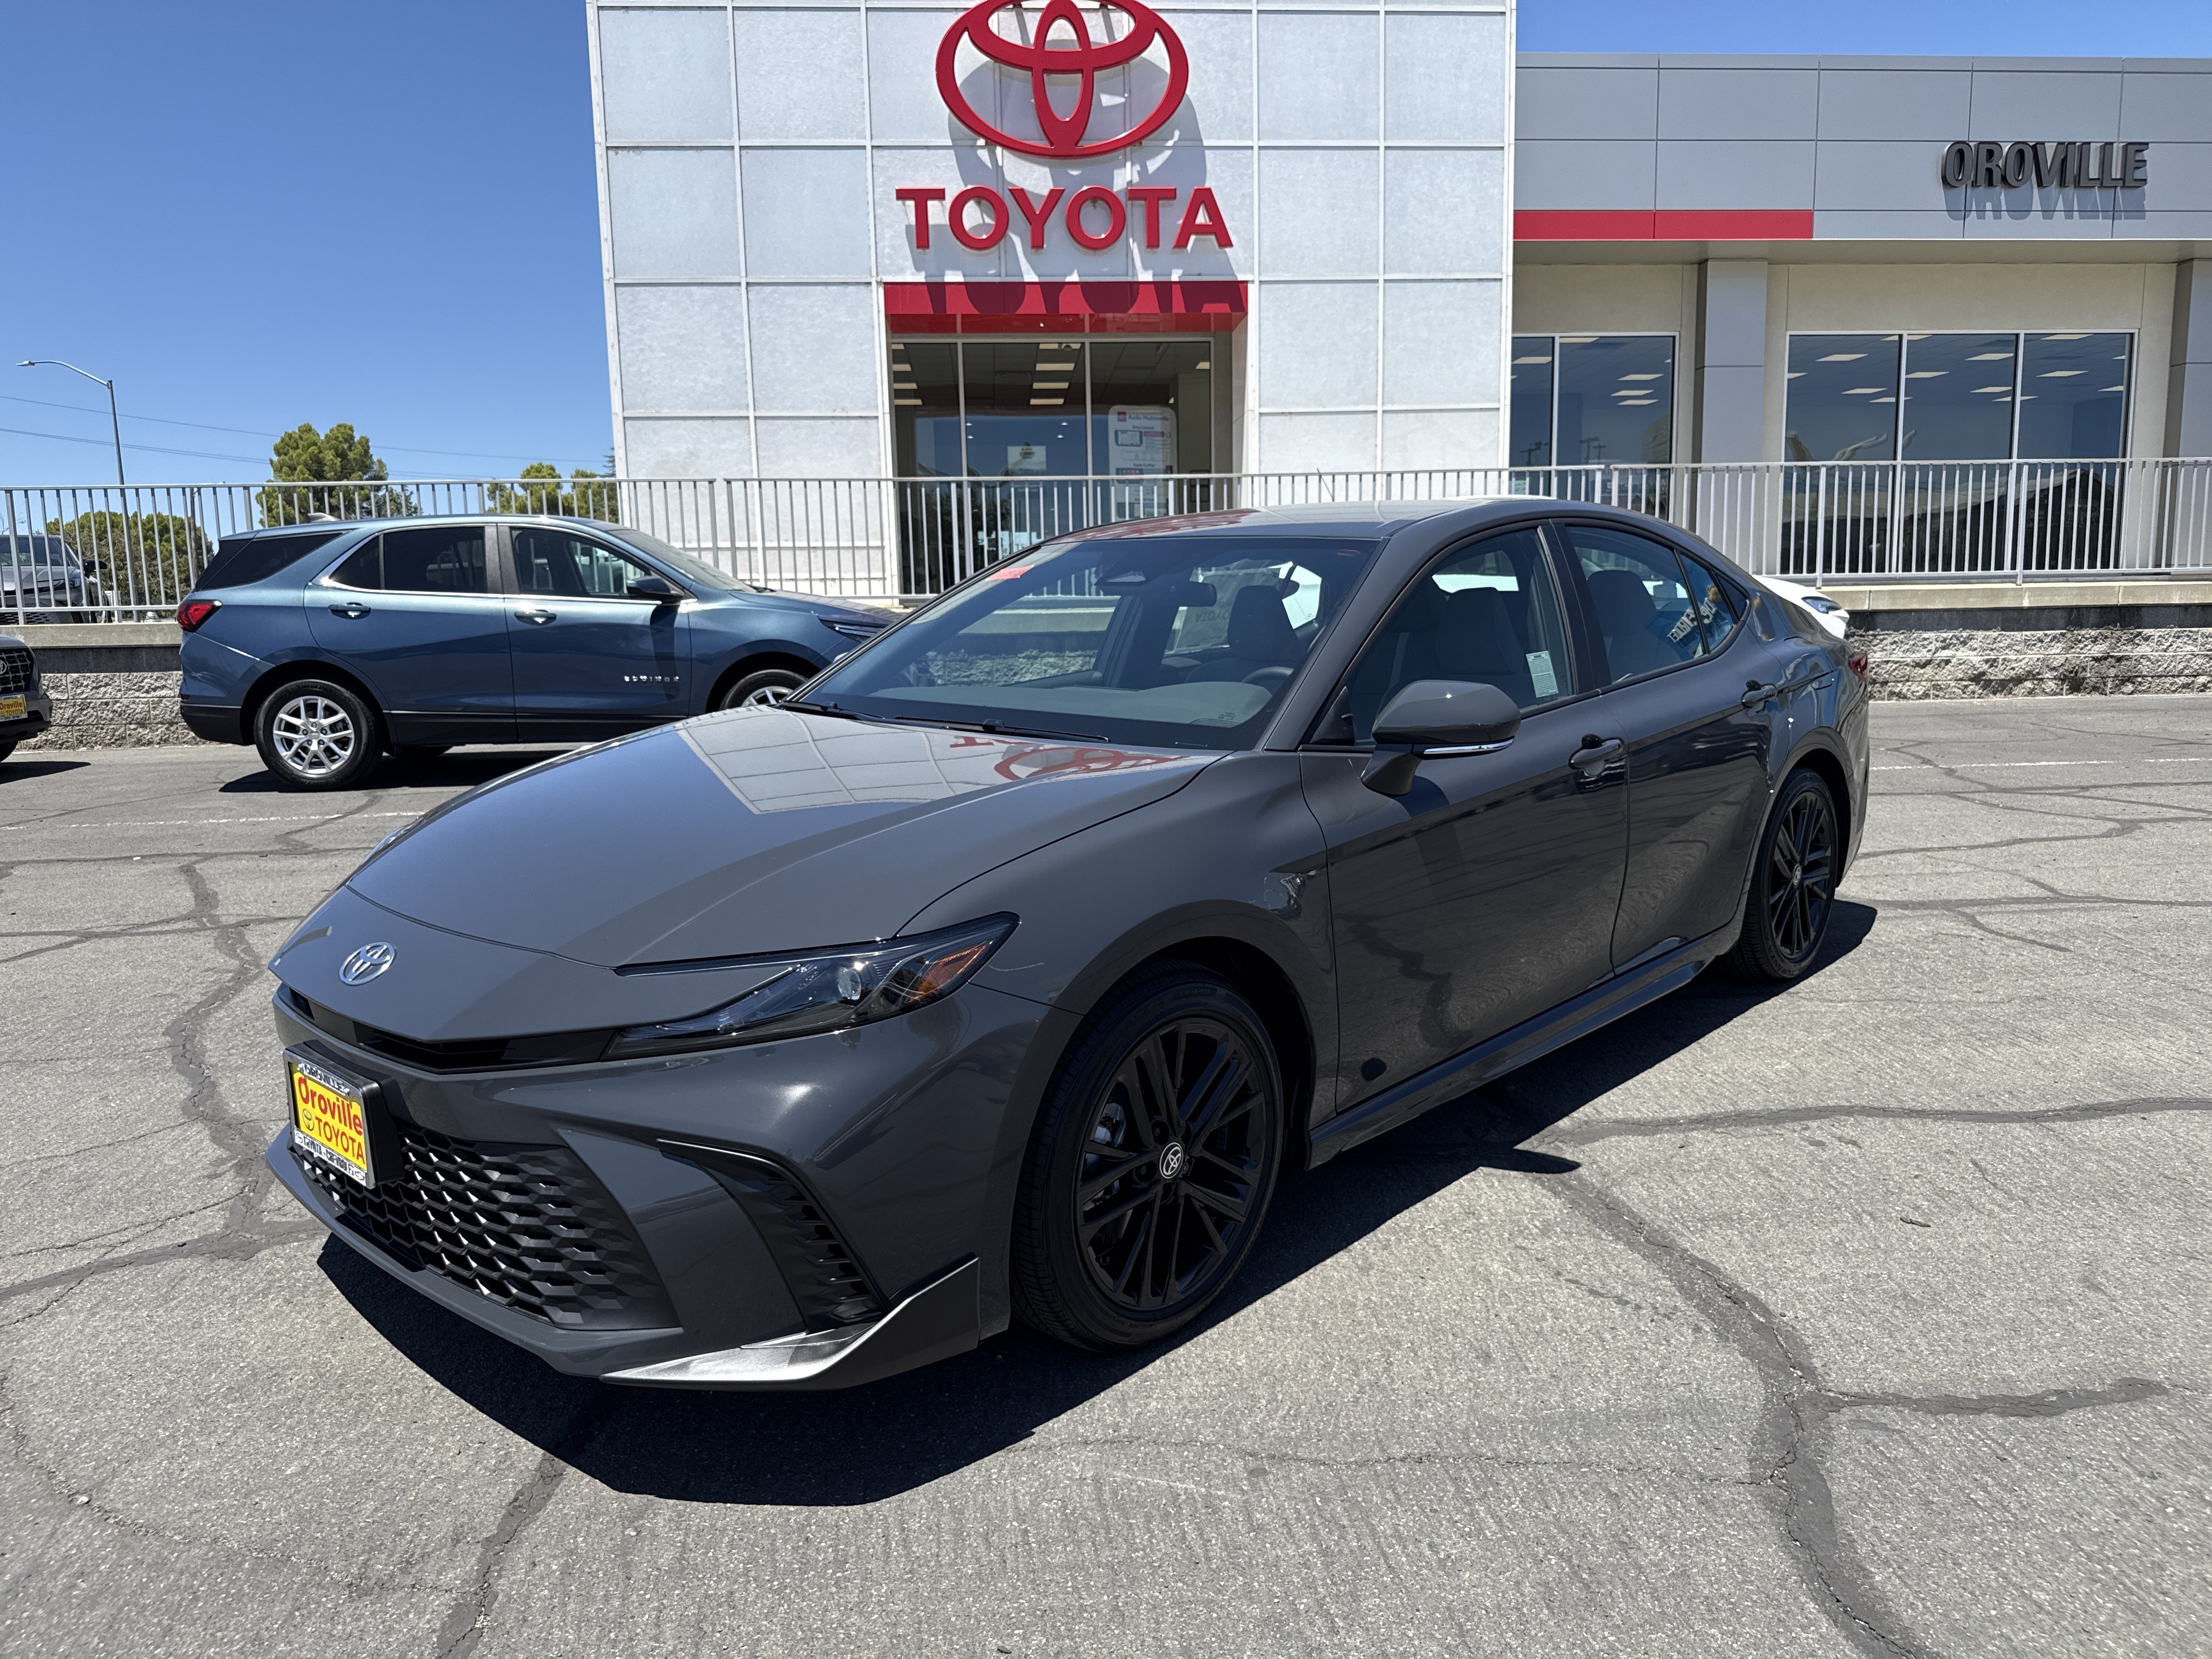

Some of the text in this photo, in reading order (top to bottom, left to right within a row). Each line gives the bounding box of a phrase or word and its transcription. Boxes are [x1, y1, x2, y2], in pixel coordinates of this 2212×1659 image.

[1941, 140, 2149, 188] OROVILLE
[895, 185, 1233, 251] TOYOTA
[298, 1076, 363, 1136] Oroville
[315, 1117, 365, 1165] TOYOTA
